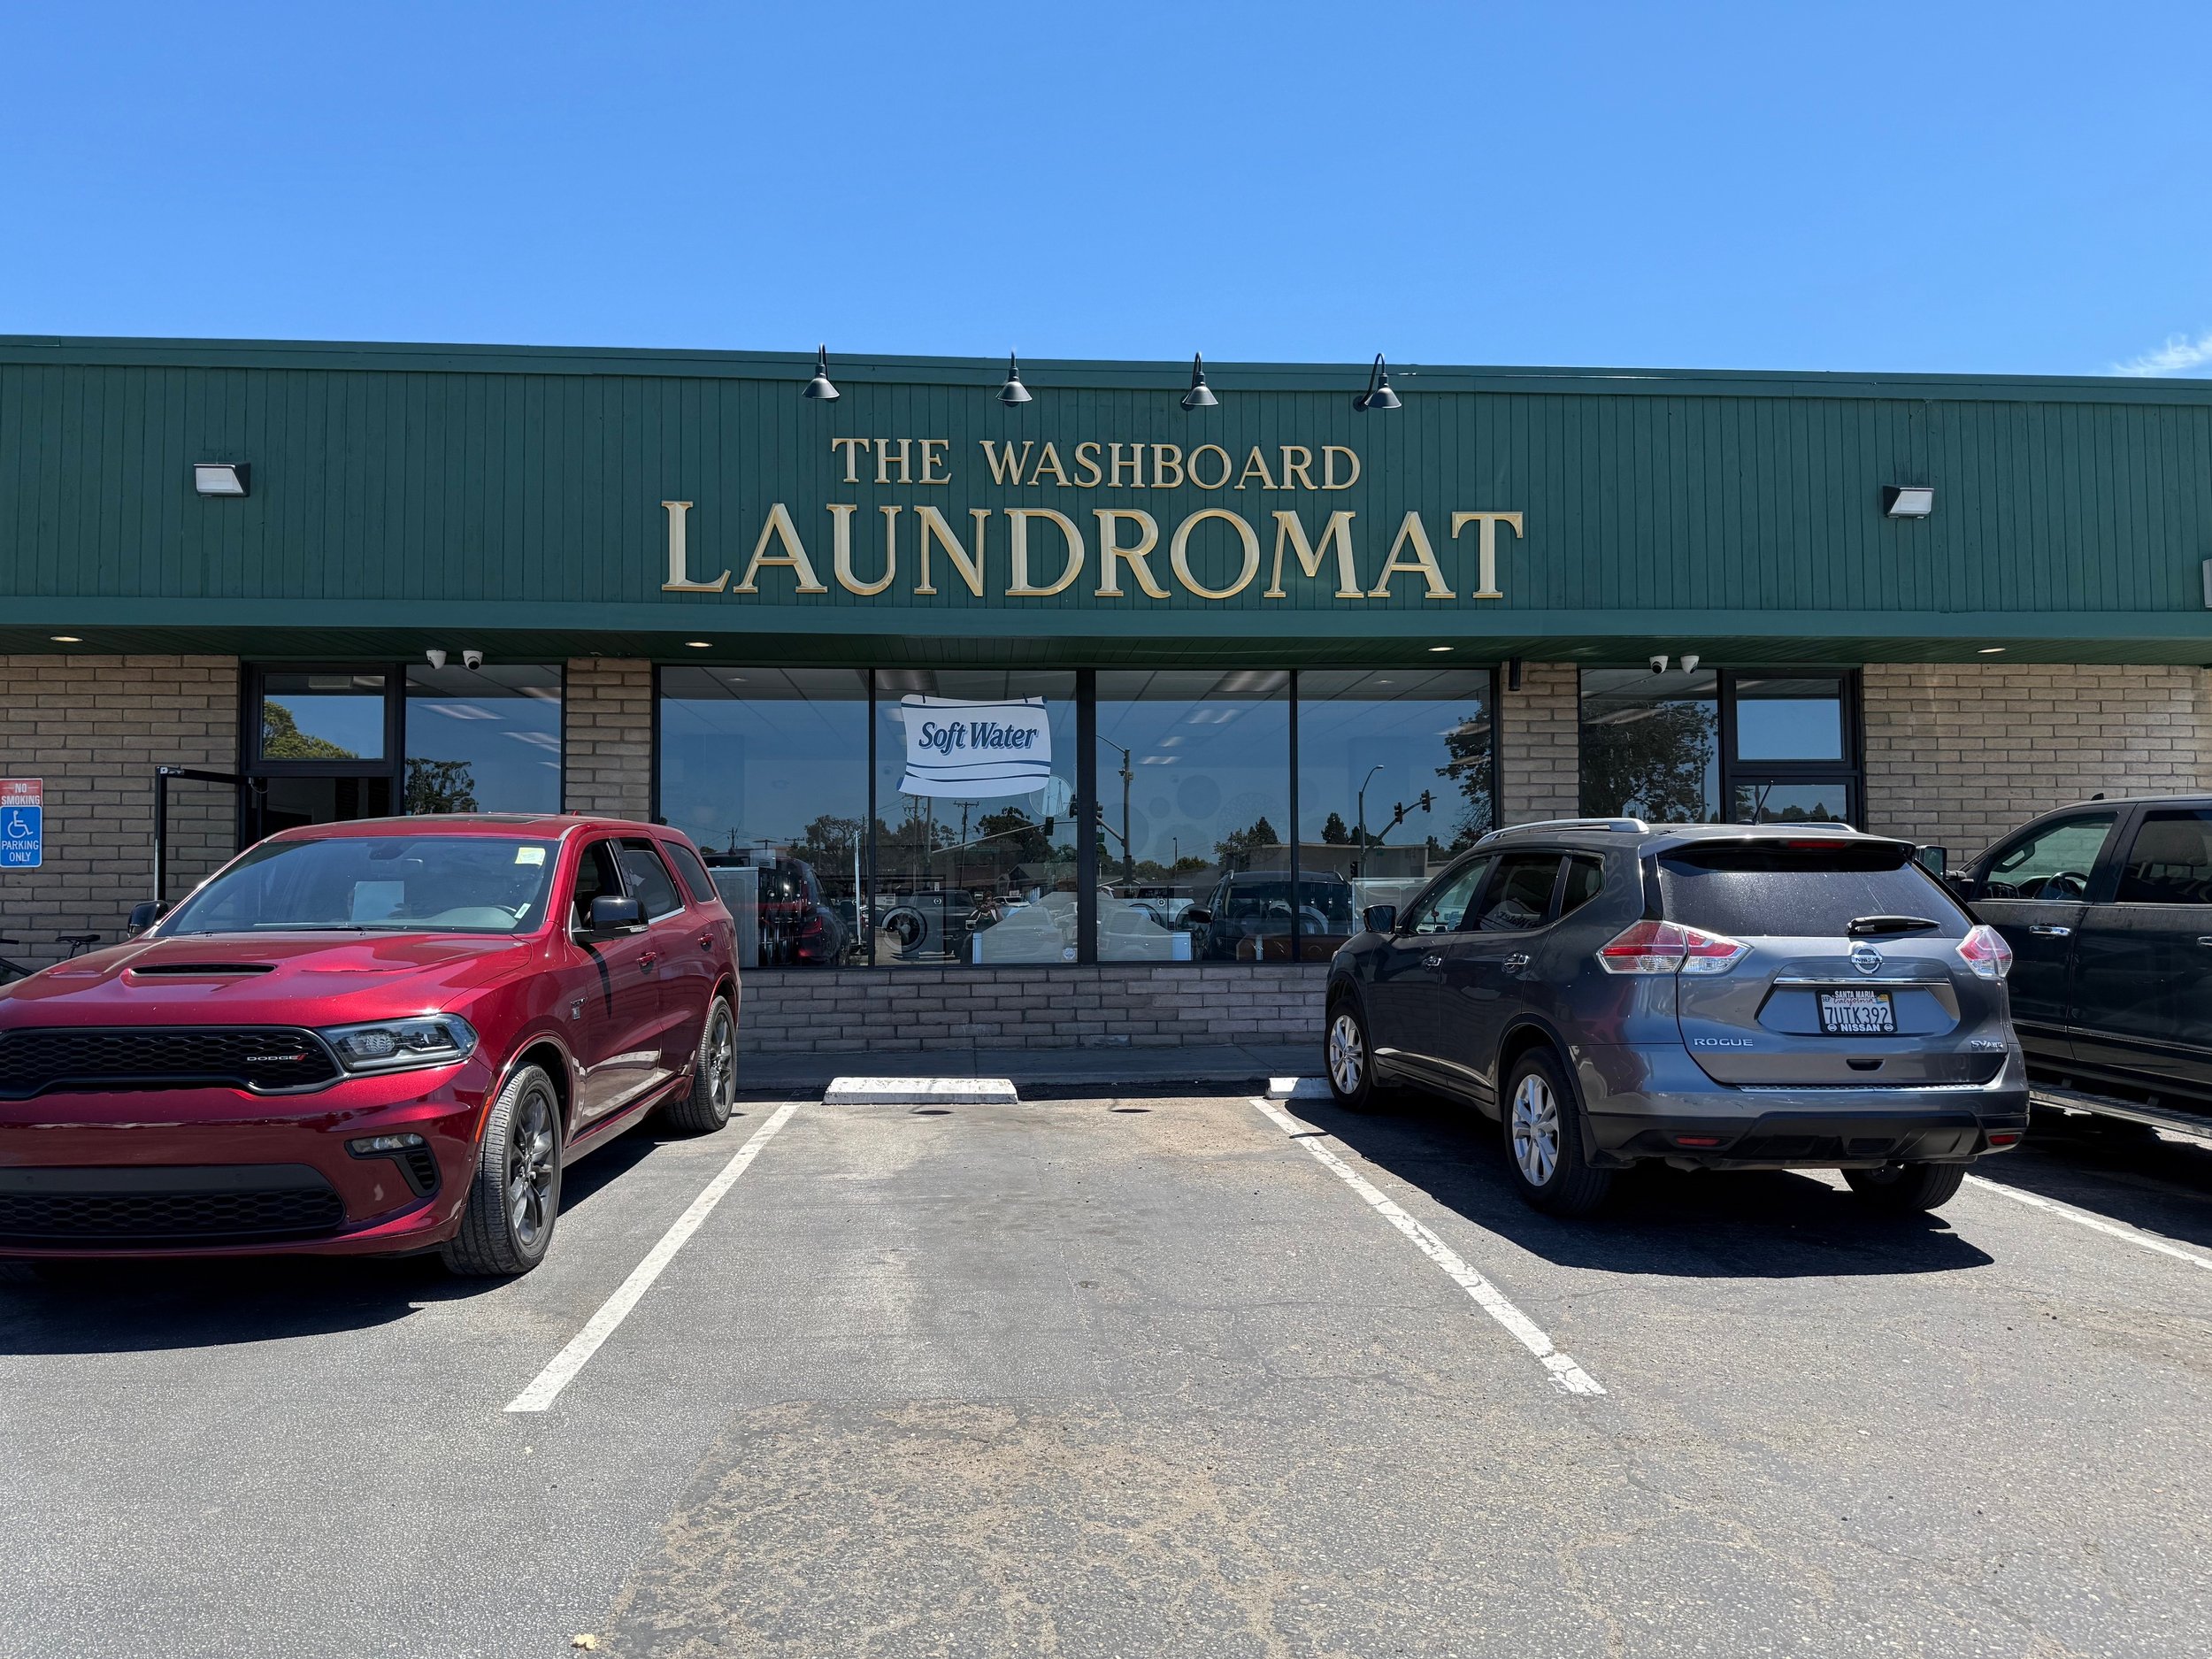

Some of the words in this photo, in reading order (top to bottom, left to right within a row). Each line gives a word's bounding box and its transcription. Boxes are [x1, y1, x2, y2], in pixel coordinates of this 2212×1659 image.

[831, 438, 952, 485] THE
[979, 440, 1362, 491] WASHBOARD
[661, 500, 1524, 600] LAUNDROMAT
[918, 721, 968, 756] Soft
[969, 721, 1039, 749] Water
[14, 783, 27, 794] NO
[1, 795, 41, 805] SMOKING
[1, 840, 39, 850] PARKING
[9, 851, 32, 862] ONLY
[1834, 990, 1855, 999] SANTA
[1855, 990, 1875, 999] MARIA
